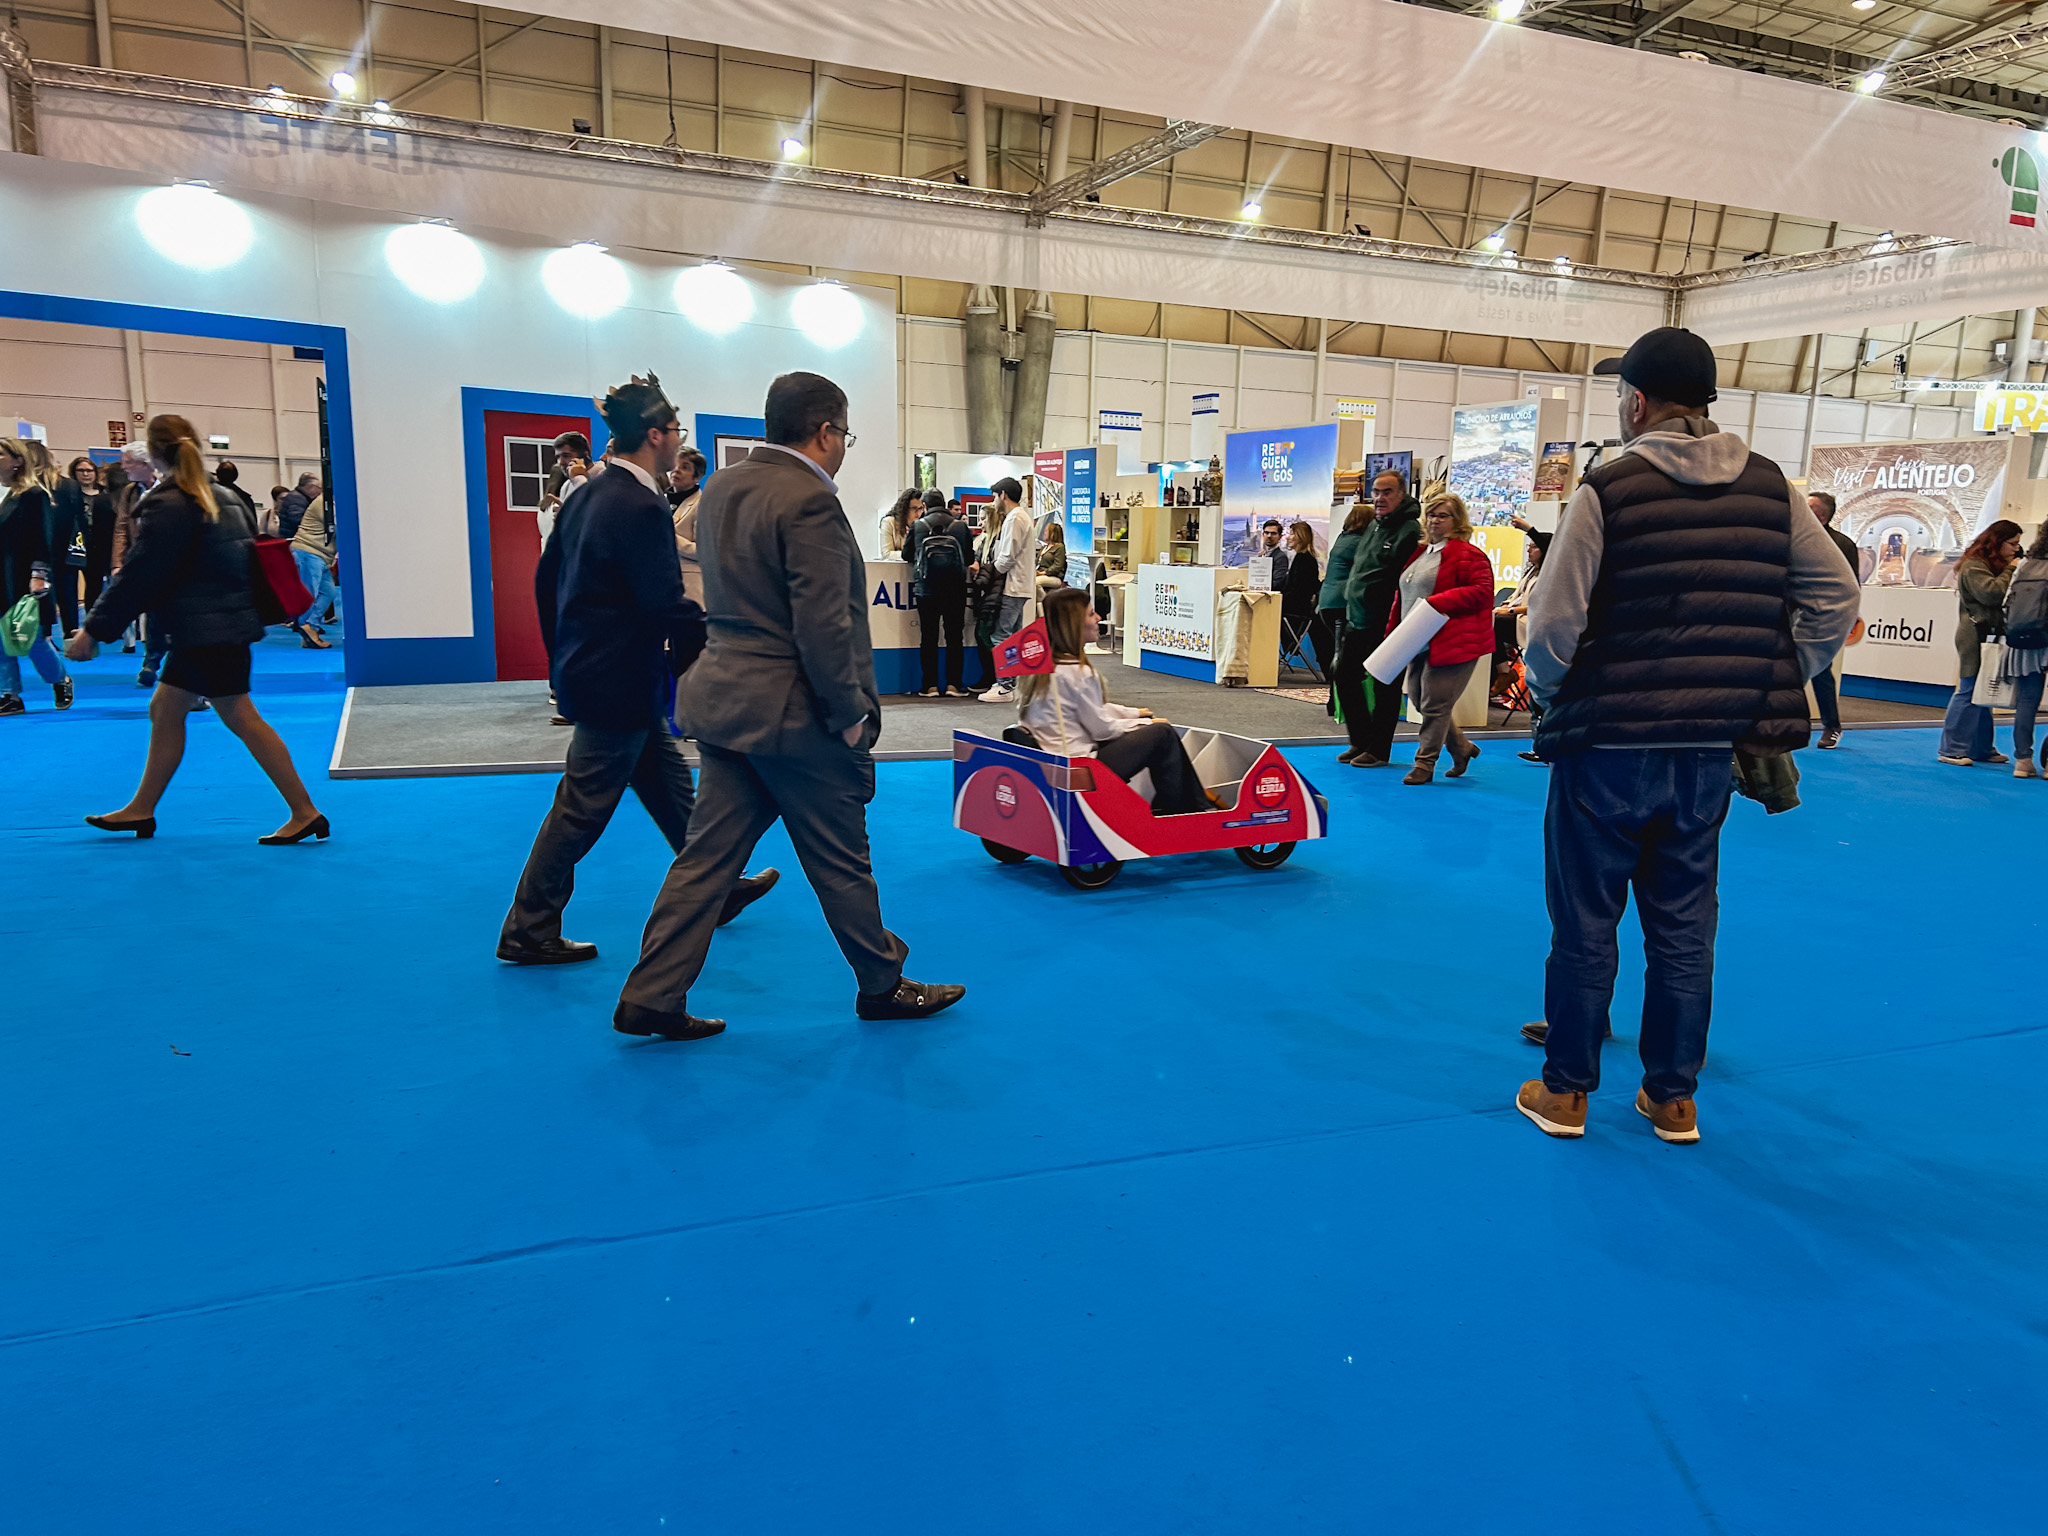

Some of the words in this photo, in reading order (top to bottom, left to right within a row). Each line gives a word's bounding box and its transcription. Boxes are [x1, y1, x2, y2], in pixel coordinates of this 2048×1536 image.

[1833, 462, 1876, 488] Visit
[1873, 463, 1975, 490] ALENTEJO
[1493, 565, 1522, 582] LOS
[1867, 618, 1933, 642] cimbal
